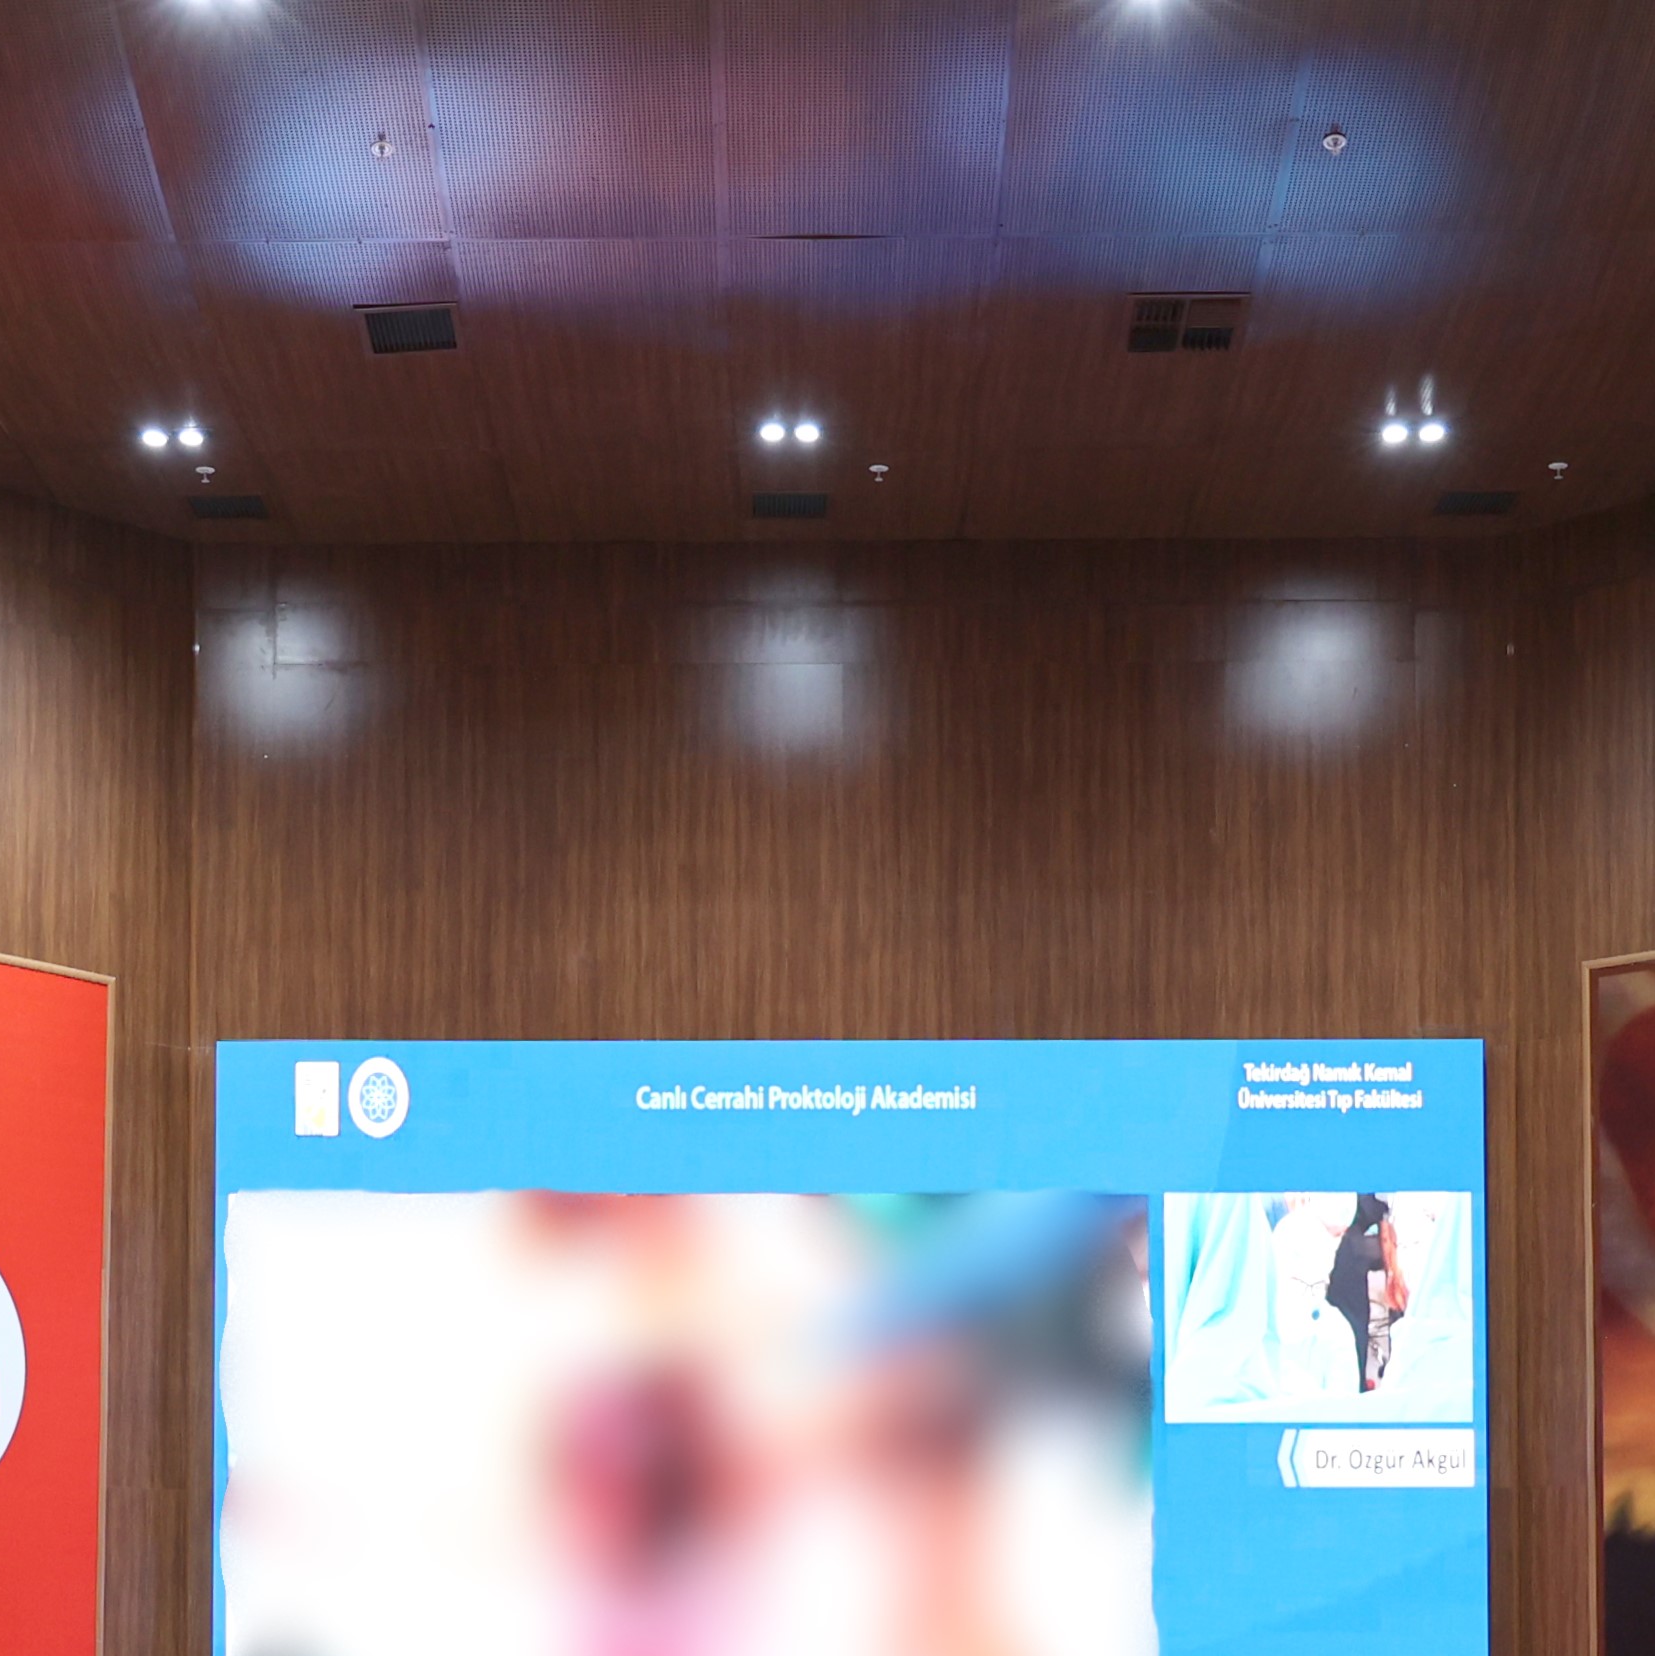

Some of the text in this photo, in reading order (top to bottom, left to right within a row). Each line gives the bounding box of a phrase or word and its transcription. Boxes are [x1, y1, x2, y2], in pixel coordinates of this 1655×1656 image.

[1243, 1062, 1413, 1086] Tekirdağ Namık Kemal
[636, 1085, 977, 1116] Canlı Cerrahi Proktoloji Akademisi
[1238, 1087, 1424, 1113] Üniversitesi Tıp Fakültesi
[1315, 1450, 1341, 1470] Dr.
